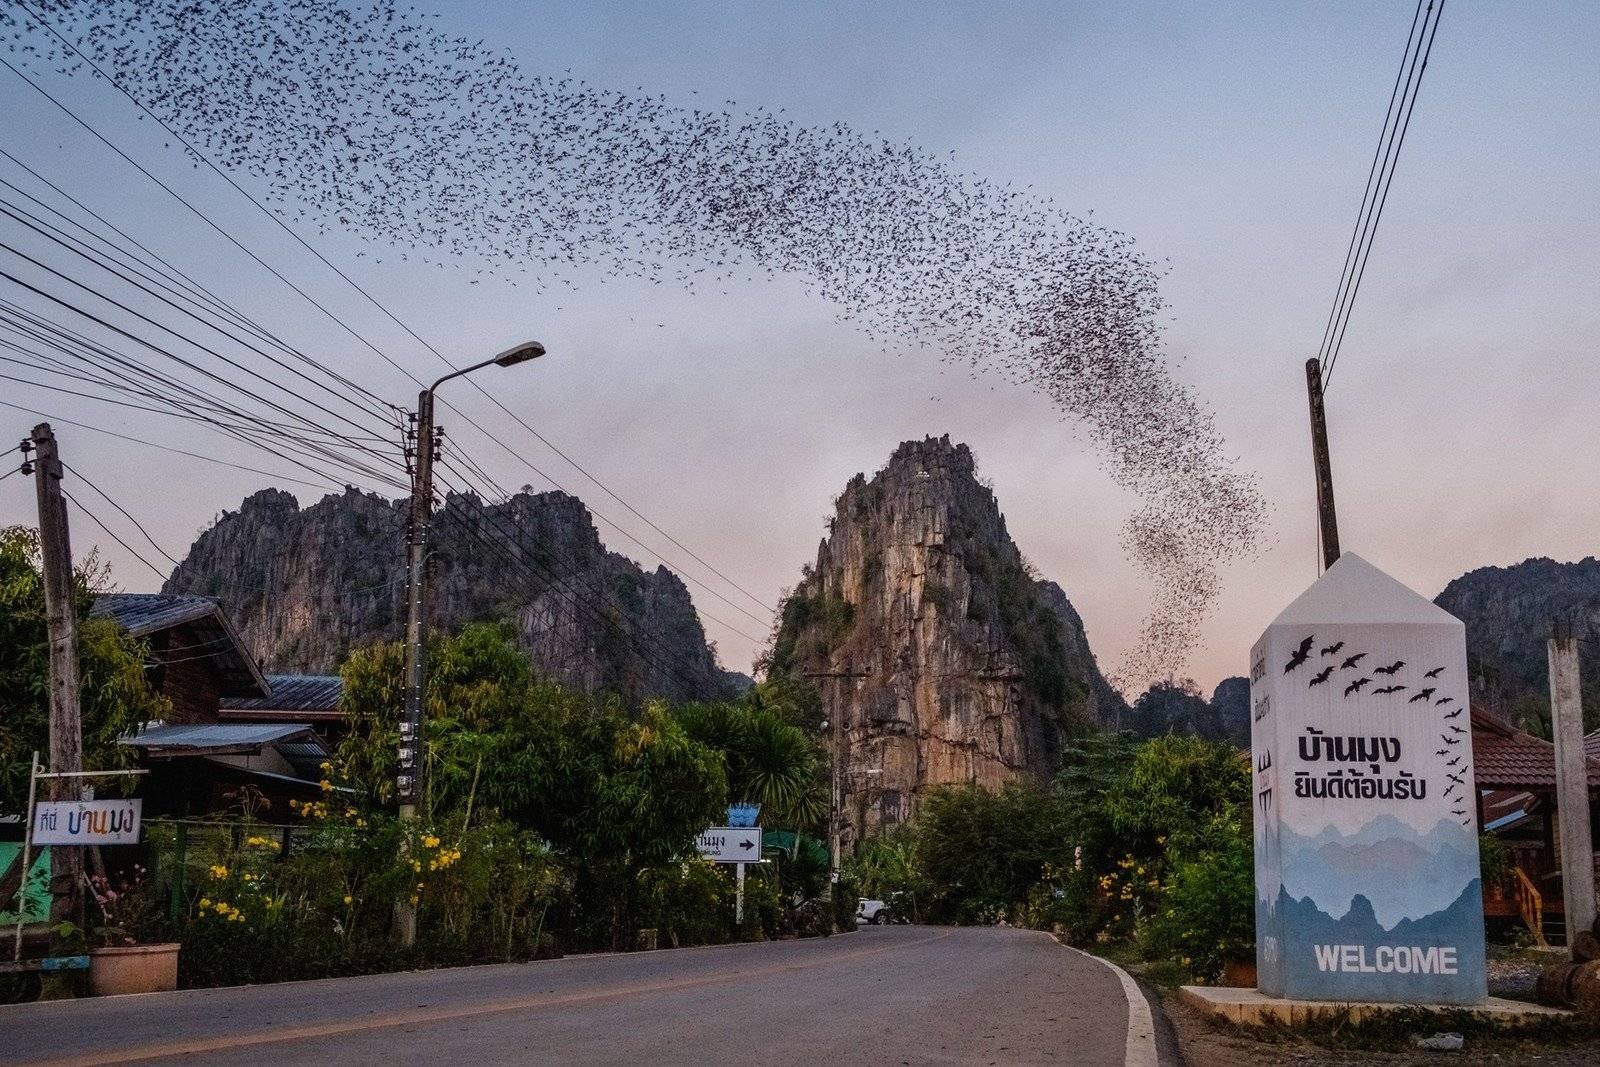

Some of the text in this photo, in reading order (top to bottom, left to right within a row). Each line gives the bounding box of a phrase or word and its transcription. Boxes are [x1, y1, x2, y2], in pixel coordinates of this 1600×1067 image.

[1298, 727, 1401, 774] บ้านมุง
[1294, 768, 1426, 800] ยินดีต้อนรับ
[1314, 944, 1458, 975] WELCOME
